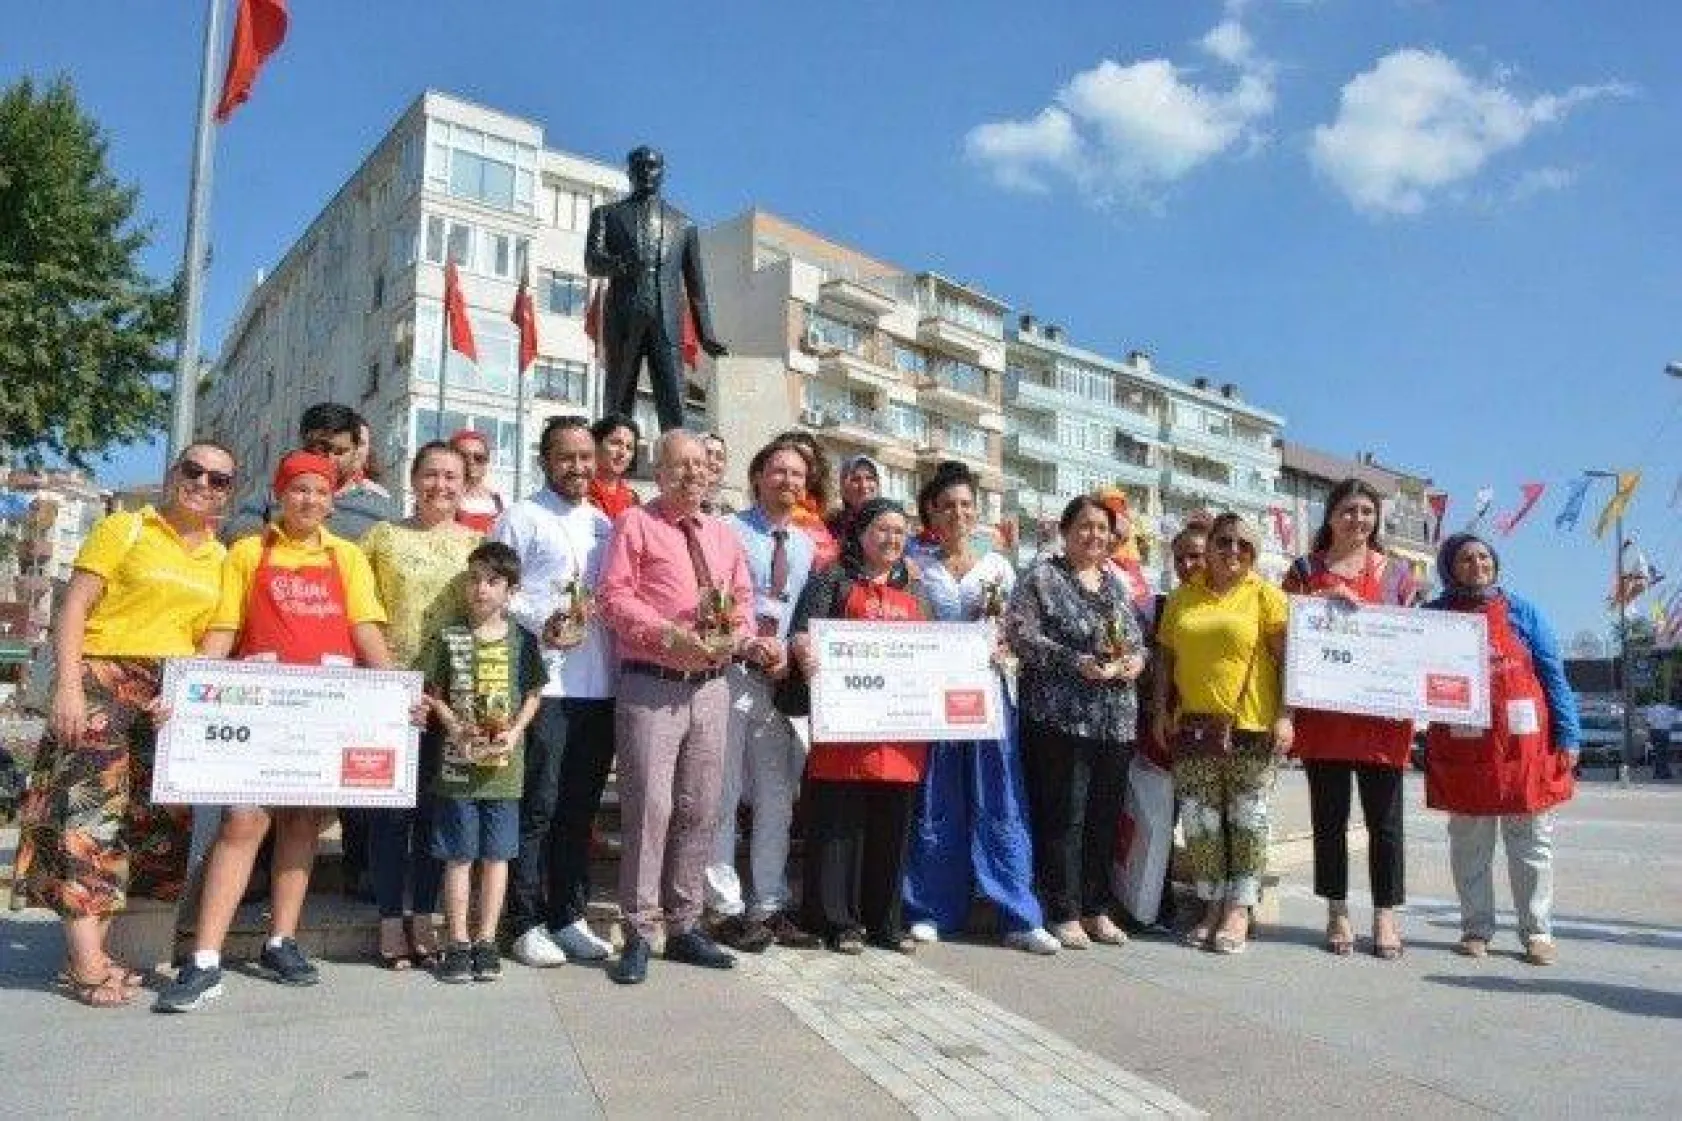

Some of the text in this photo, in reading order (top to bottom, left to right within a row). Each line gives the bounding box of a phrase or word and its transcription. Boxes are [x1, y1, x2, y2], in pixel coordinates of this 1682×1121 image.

[1321, 648, 1352, 664] 750
[844, 675, 885, 690] 1000
[205, 724, 251, 742] 500
